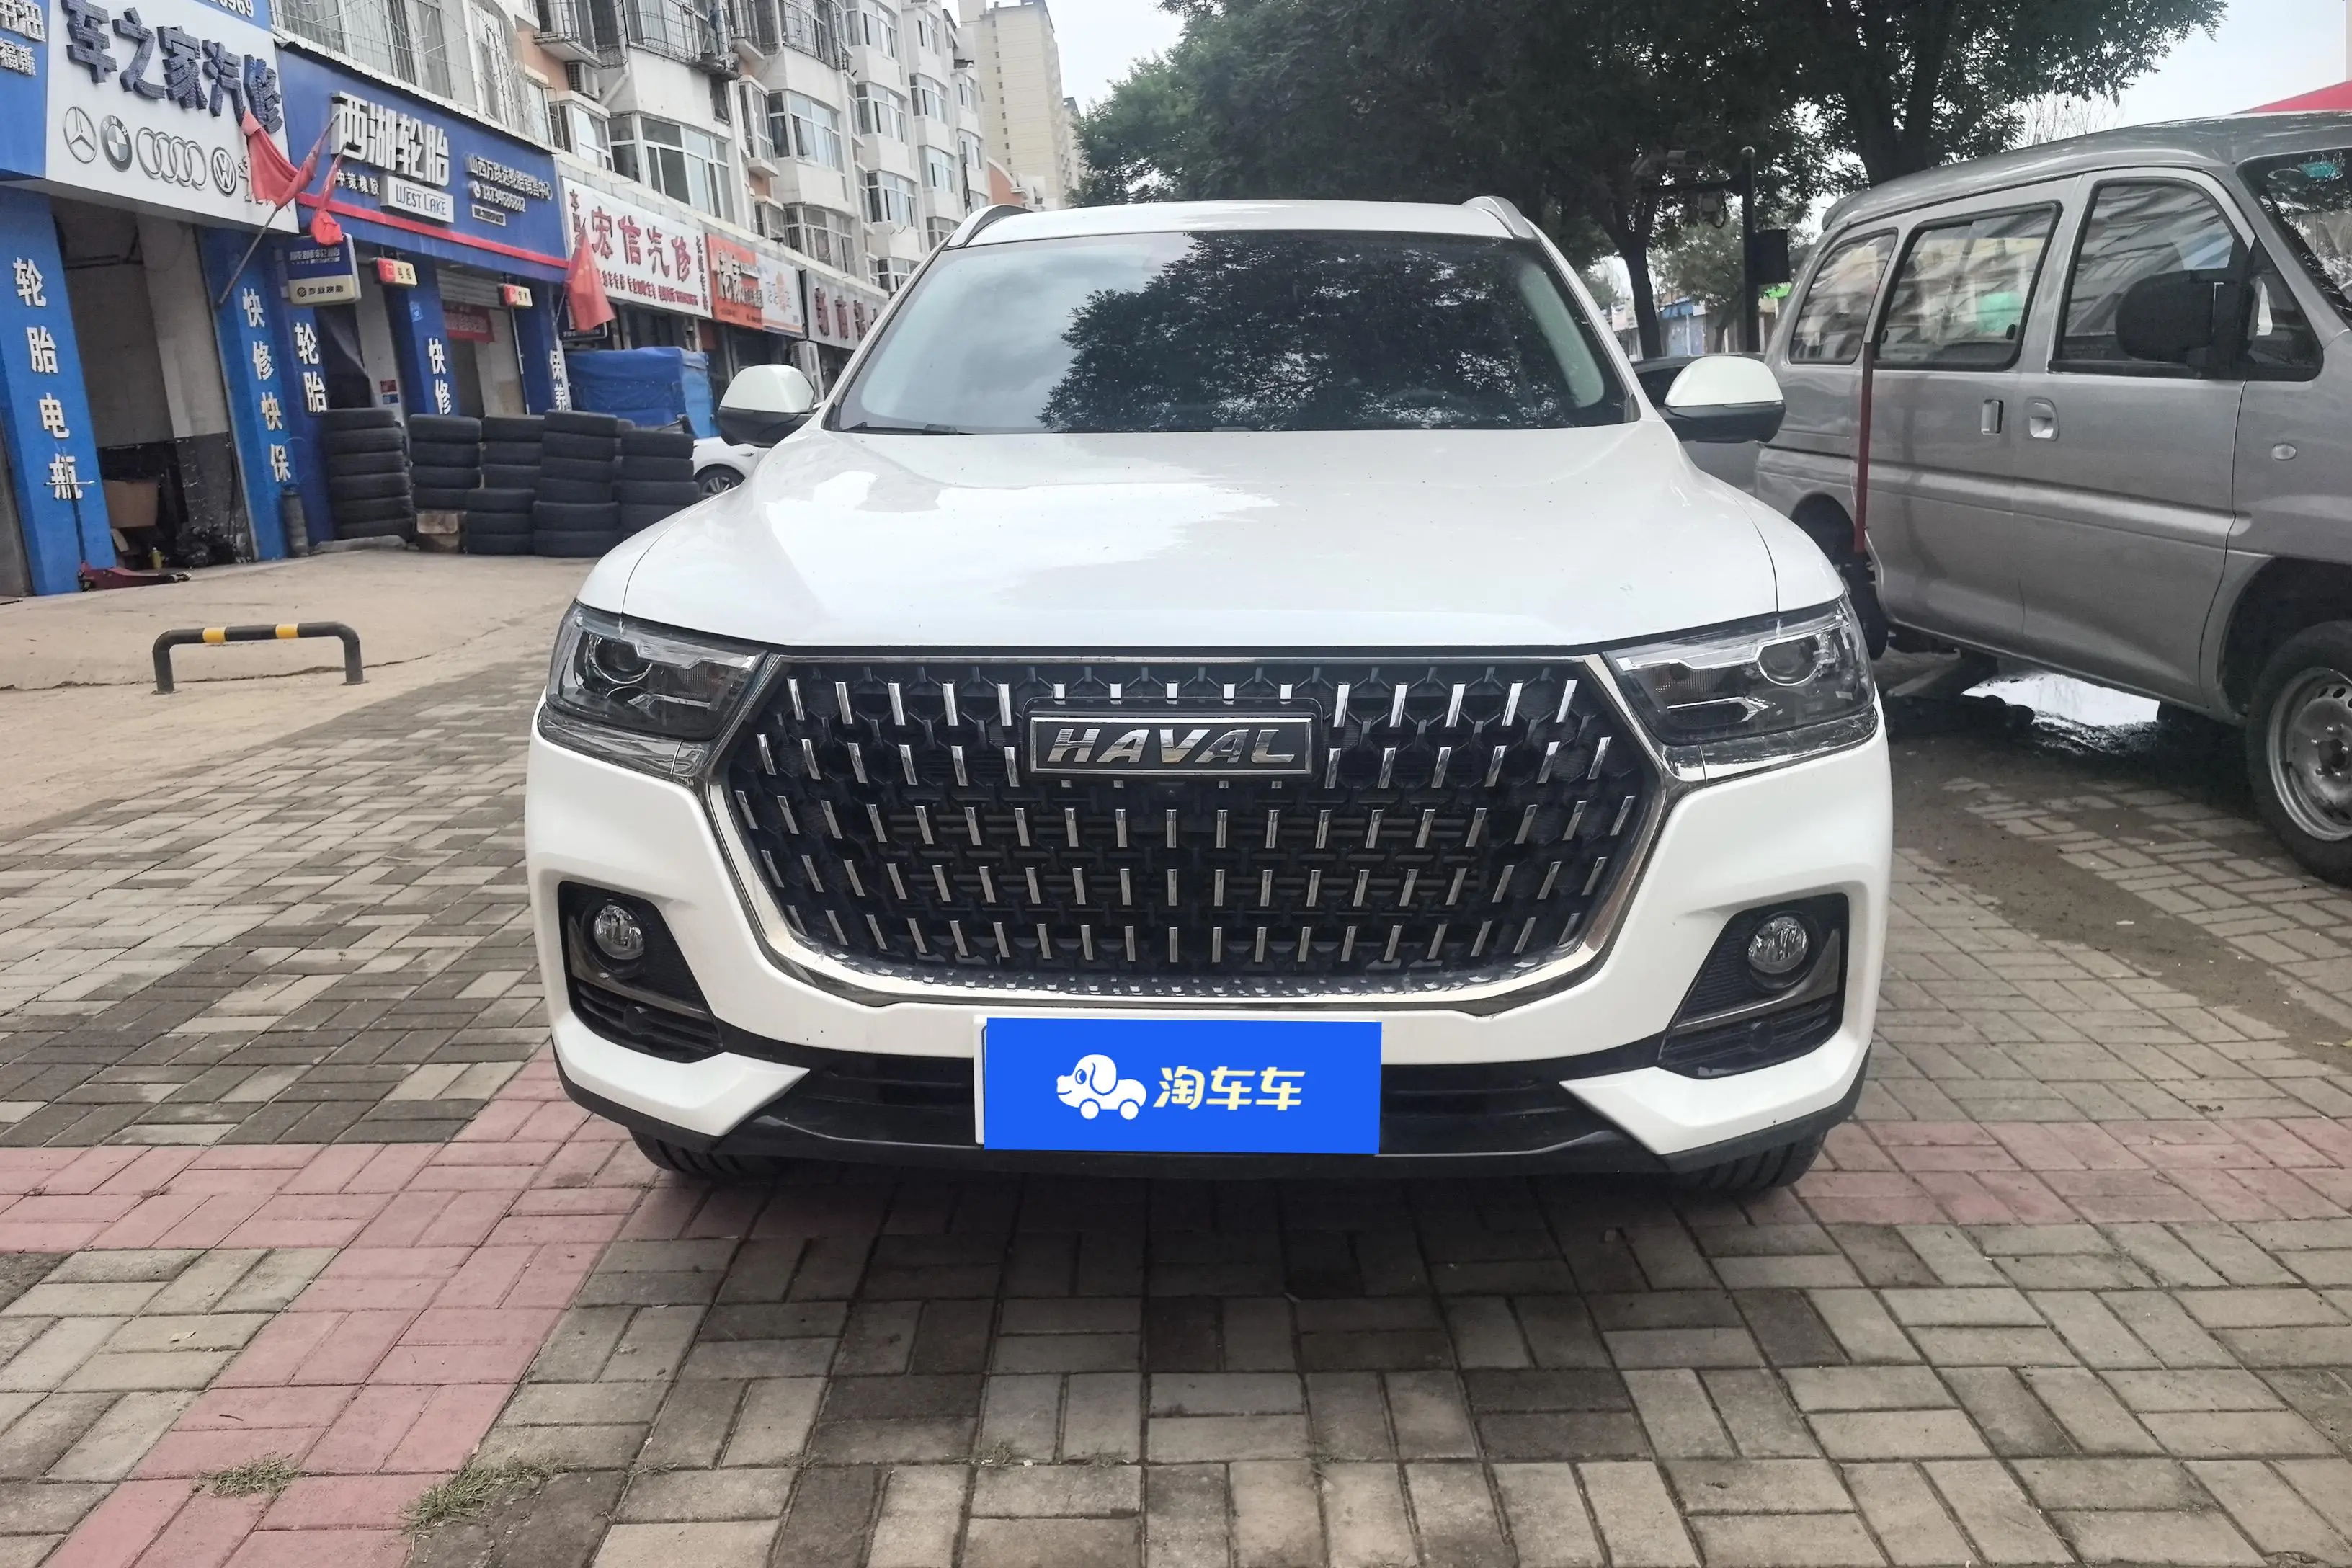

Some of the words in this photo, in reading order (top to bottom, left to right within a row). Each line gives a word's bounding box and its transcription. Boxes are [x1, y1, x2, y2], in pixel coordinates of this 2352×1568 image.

[61, 0, 284, 134] 车之家汽修
[332, 91, 450, 187] 西湖轮胎
[396, 184, 424, 209] WEST
[424, 192, 447, 216] LAKE
[591, 205, 692, 282] 宏信汽修
[12, 257, 84, 500] 轮胎电瓶
[242, 288, 292, 483] 快修快保
[294, 322, 329, 414] 轮胎
[428, 337, 452, 415] 快修
[549, 349, 568, 411] 保养
[1047, 728, 1295, 764] HAVAL
